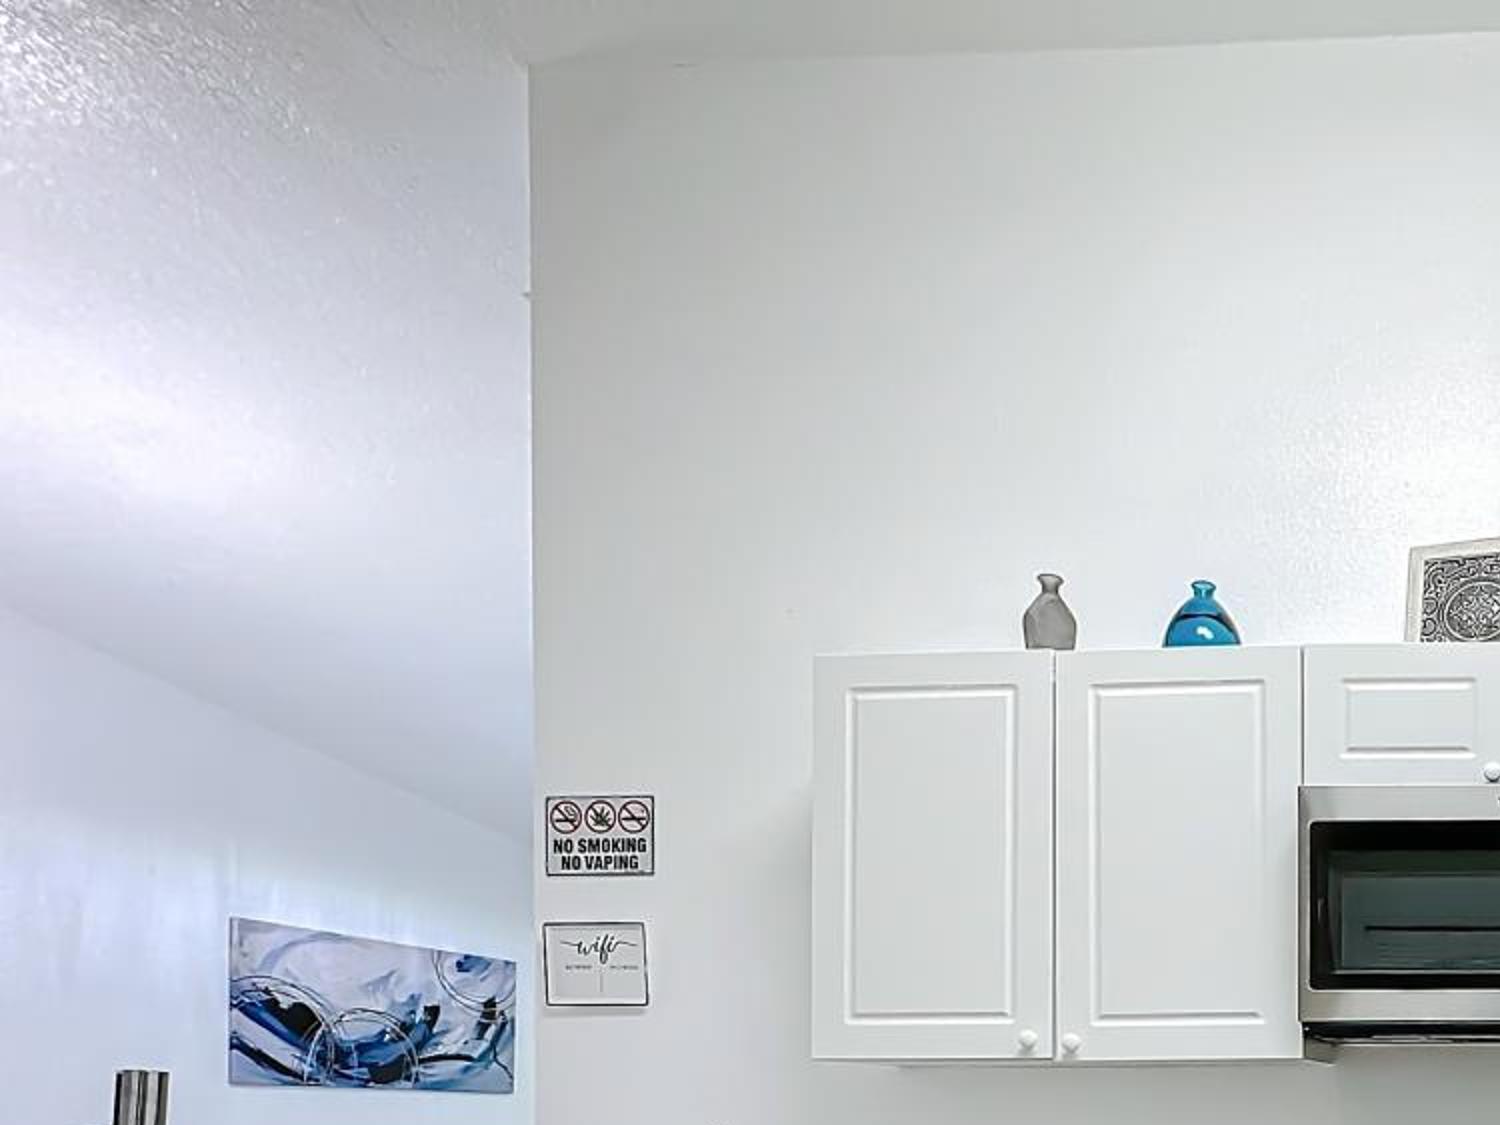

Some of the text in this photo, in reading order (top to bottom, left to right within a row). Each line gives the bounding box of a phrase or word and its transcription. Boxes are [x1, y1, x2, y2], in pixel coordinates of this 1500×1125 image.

[553, 838, 648, 854] NO SMOKING
[561, 855, 639, 870] NO VAPING
[562, 934, 637, 964] wifi
